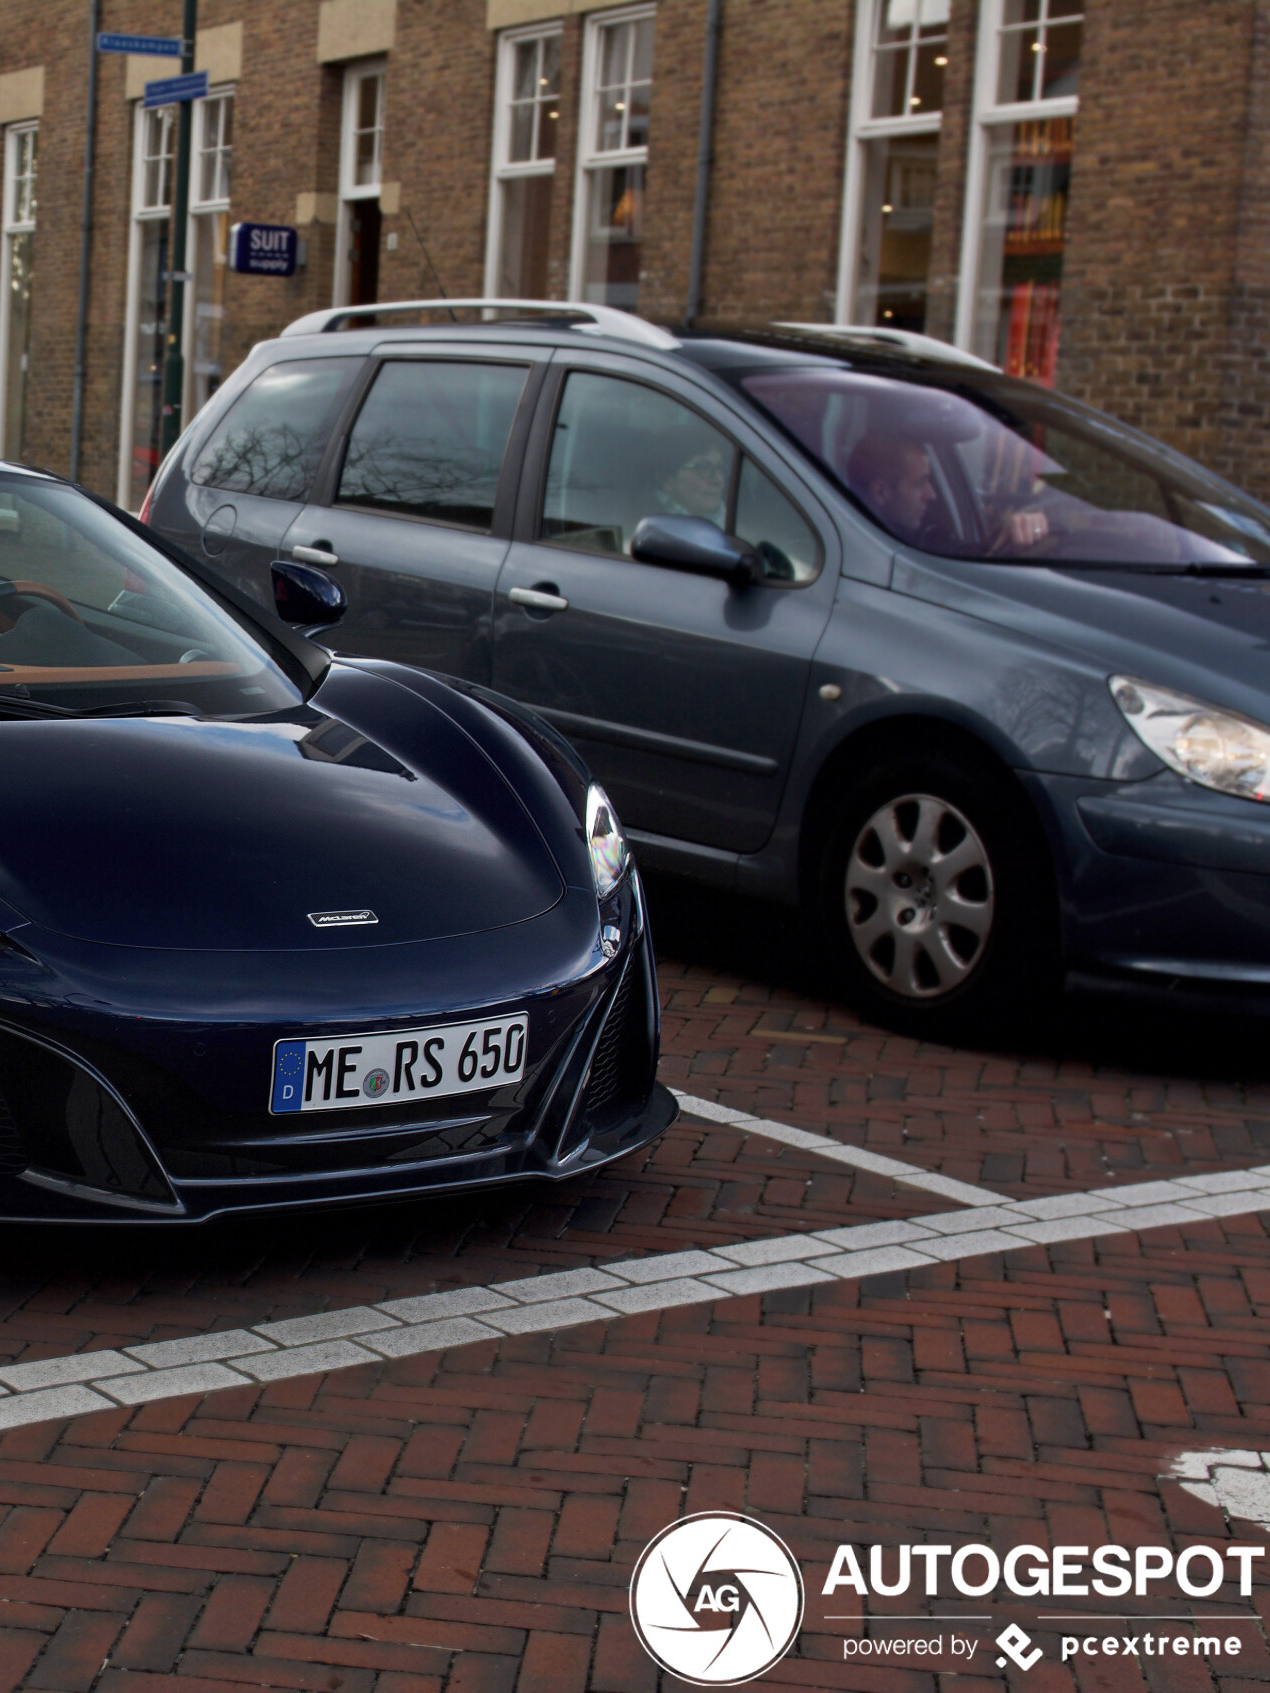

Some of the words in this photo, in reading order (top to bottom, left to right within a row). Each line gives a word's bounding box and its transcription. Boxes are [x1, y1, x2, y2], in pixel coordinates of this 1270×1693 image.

[250, 229, 290, 252] SUIT
[249, 258, 289, 271] supply
[318, 913, 369, 922] McLaren
[305, 1046, 363, 1101] ME
[393, 1037, 445, 1093] RS
[458, 1023, 525, 1082] 650
[283, 1085, 294, 1100] D
